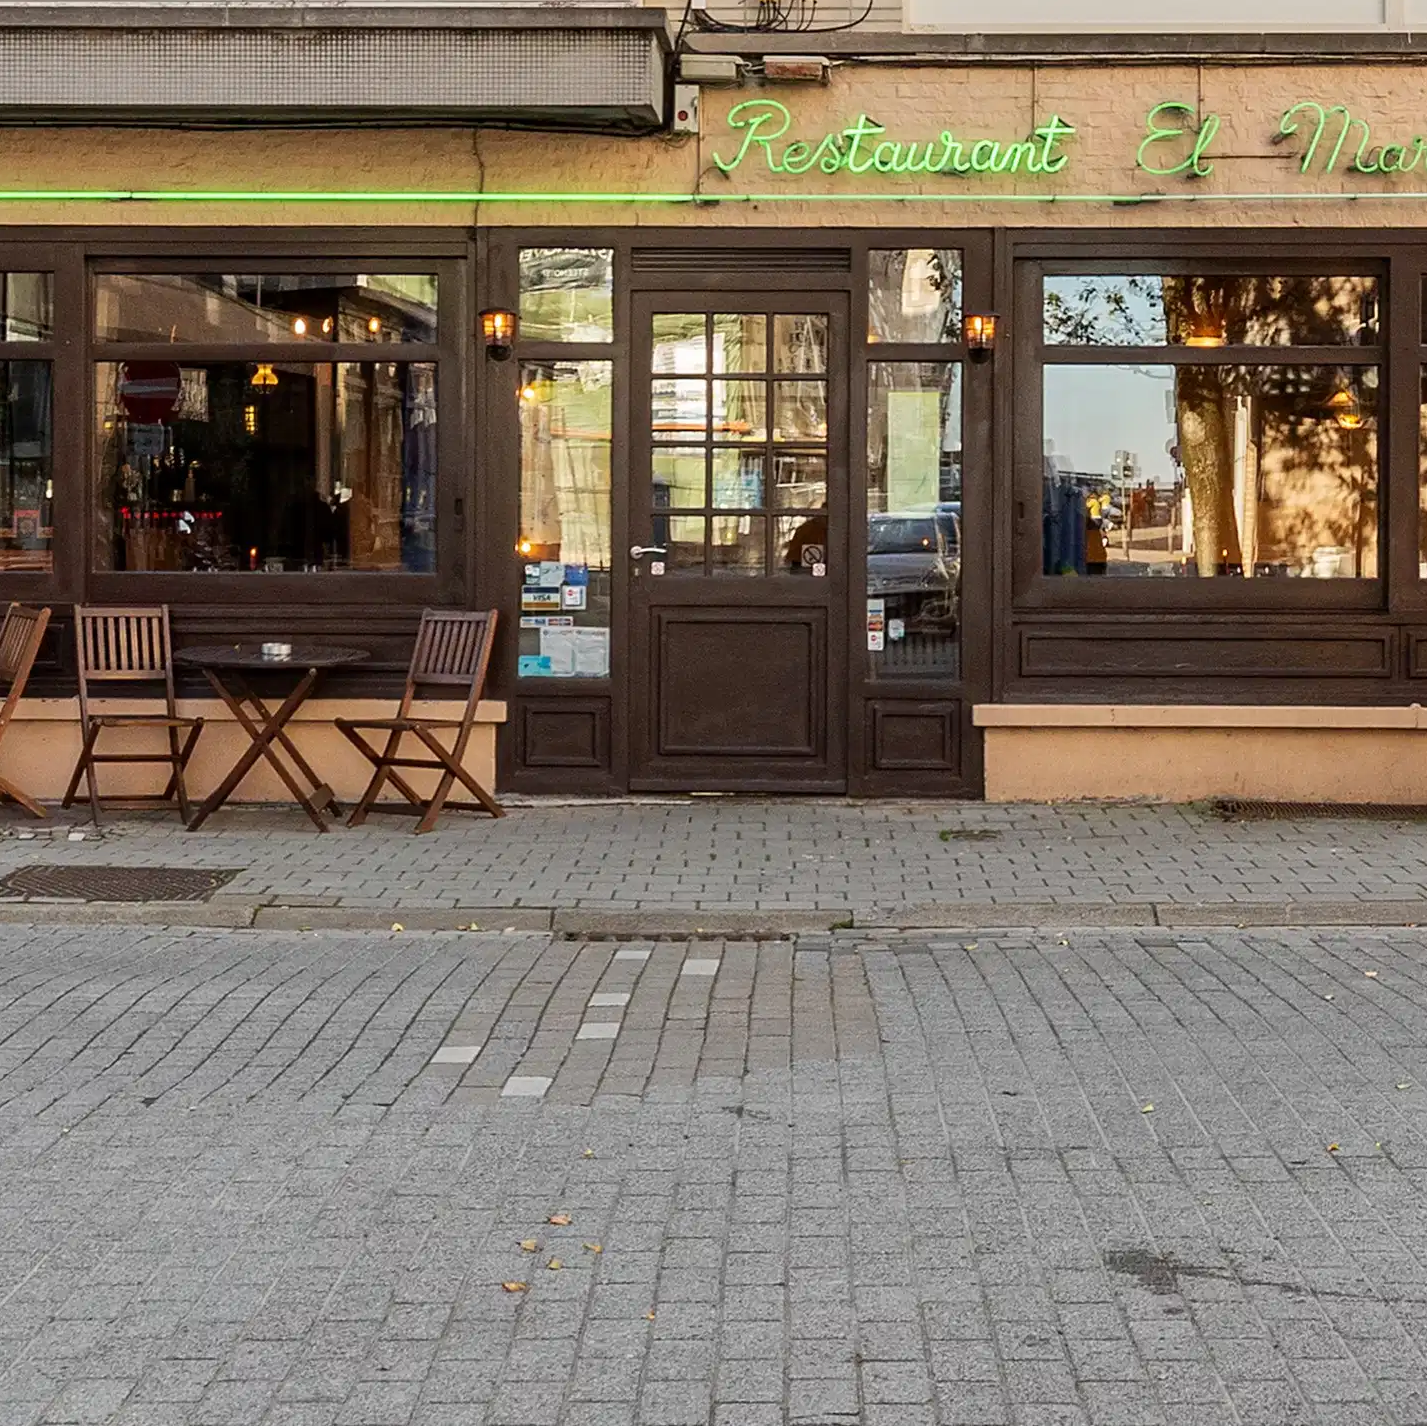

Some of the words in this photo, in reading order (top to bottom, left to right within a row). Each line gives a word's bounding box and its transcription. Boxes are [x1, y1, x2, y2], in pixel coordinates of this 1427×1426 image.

[712, 99, 1077, 174] Restaurant
[1136, 102, 1221, 176] El
[533, 594, 551, 602] VISA
